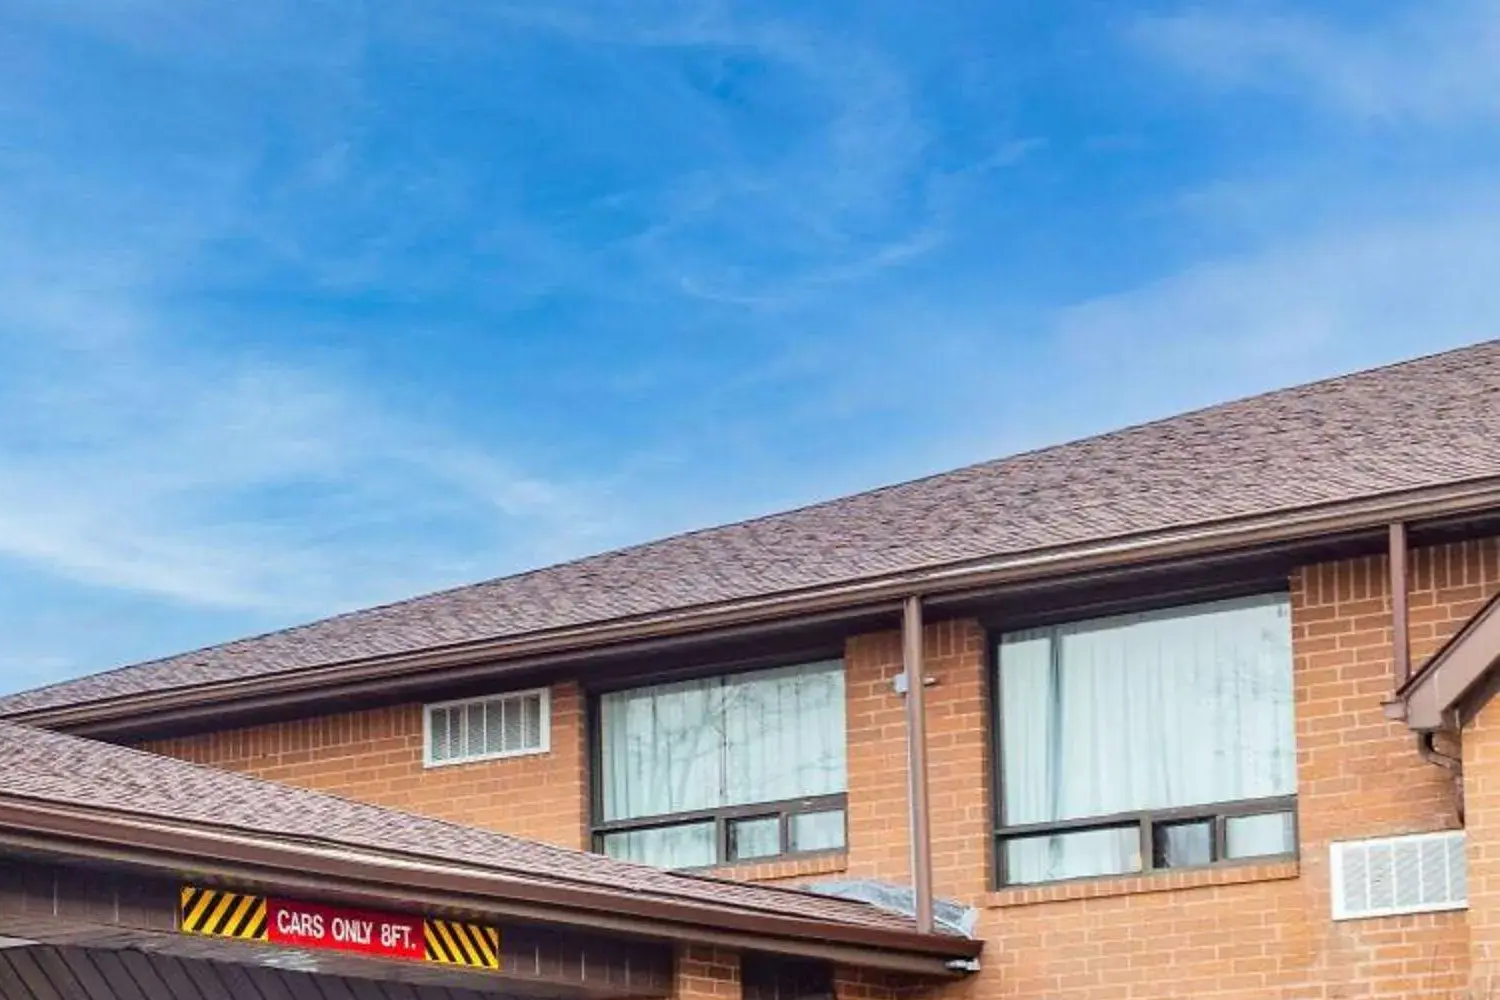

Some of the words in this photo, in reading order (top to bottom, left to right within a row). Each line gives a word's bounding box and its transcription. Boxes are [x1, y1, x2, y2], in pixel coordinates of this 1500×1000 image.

[277, 909, 325, 939] CARS
[331, 917, 373, 945] ONLY
[381, 923, 417, 949] 8FT.
